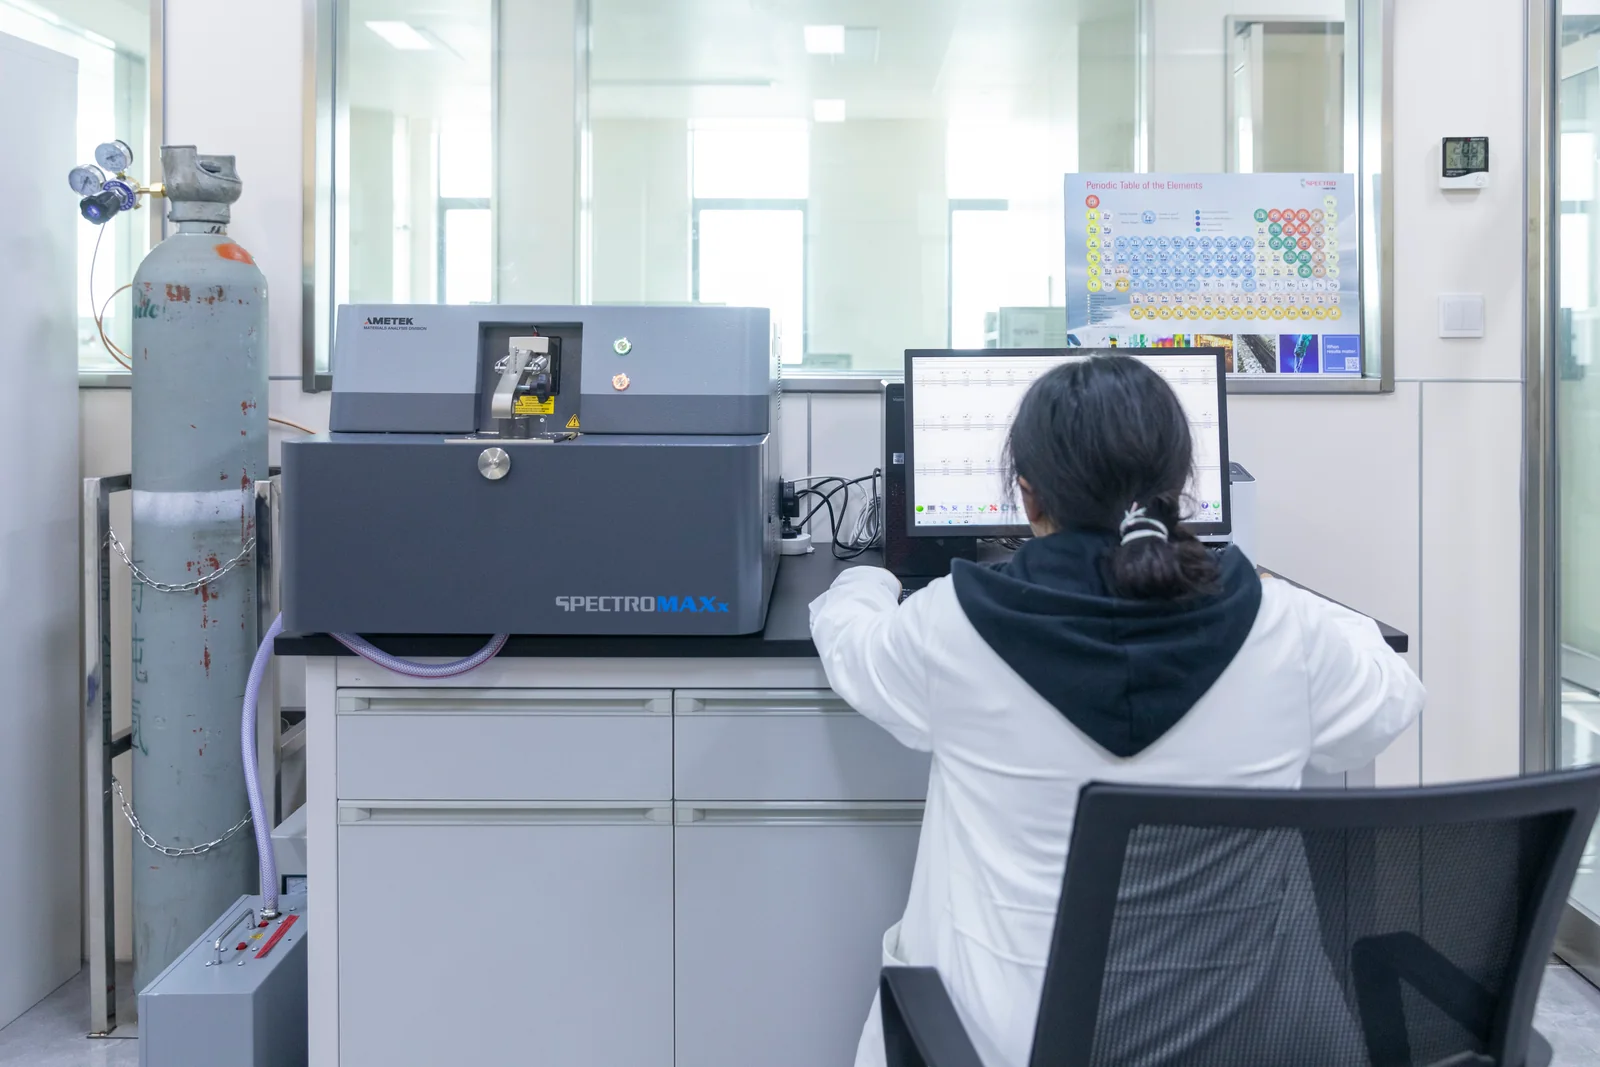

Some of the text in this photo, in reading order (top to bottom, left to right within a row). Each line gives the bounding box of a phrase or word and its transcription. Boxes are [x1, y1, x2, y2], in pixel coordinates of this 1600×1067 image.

[1086, 181, 1203, 190] Periodic Table of the Elements
[364, 317, 413, 325] AMETEK
